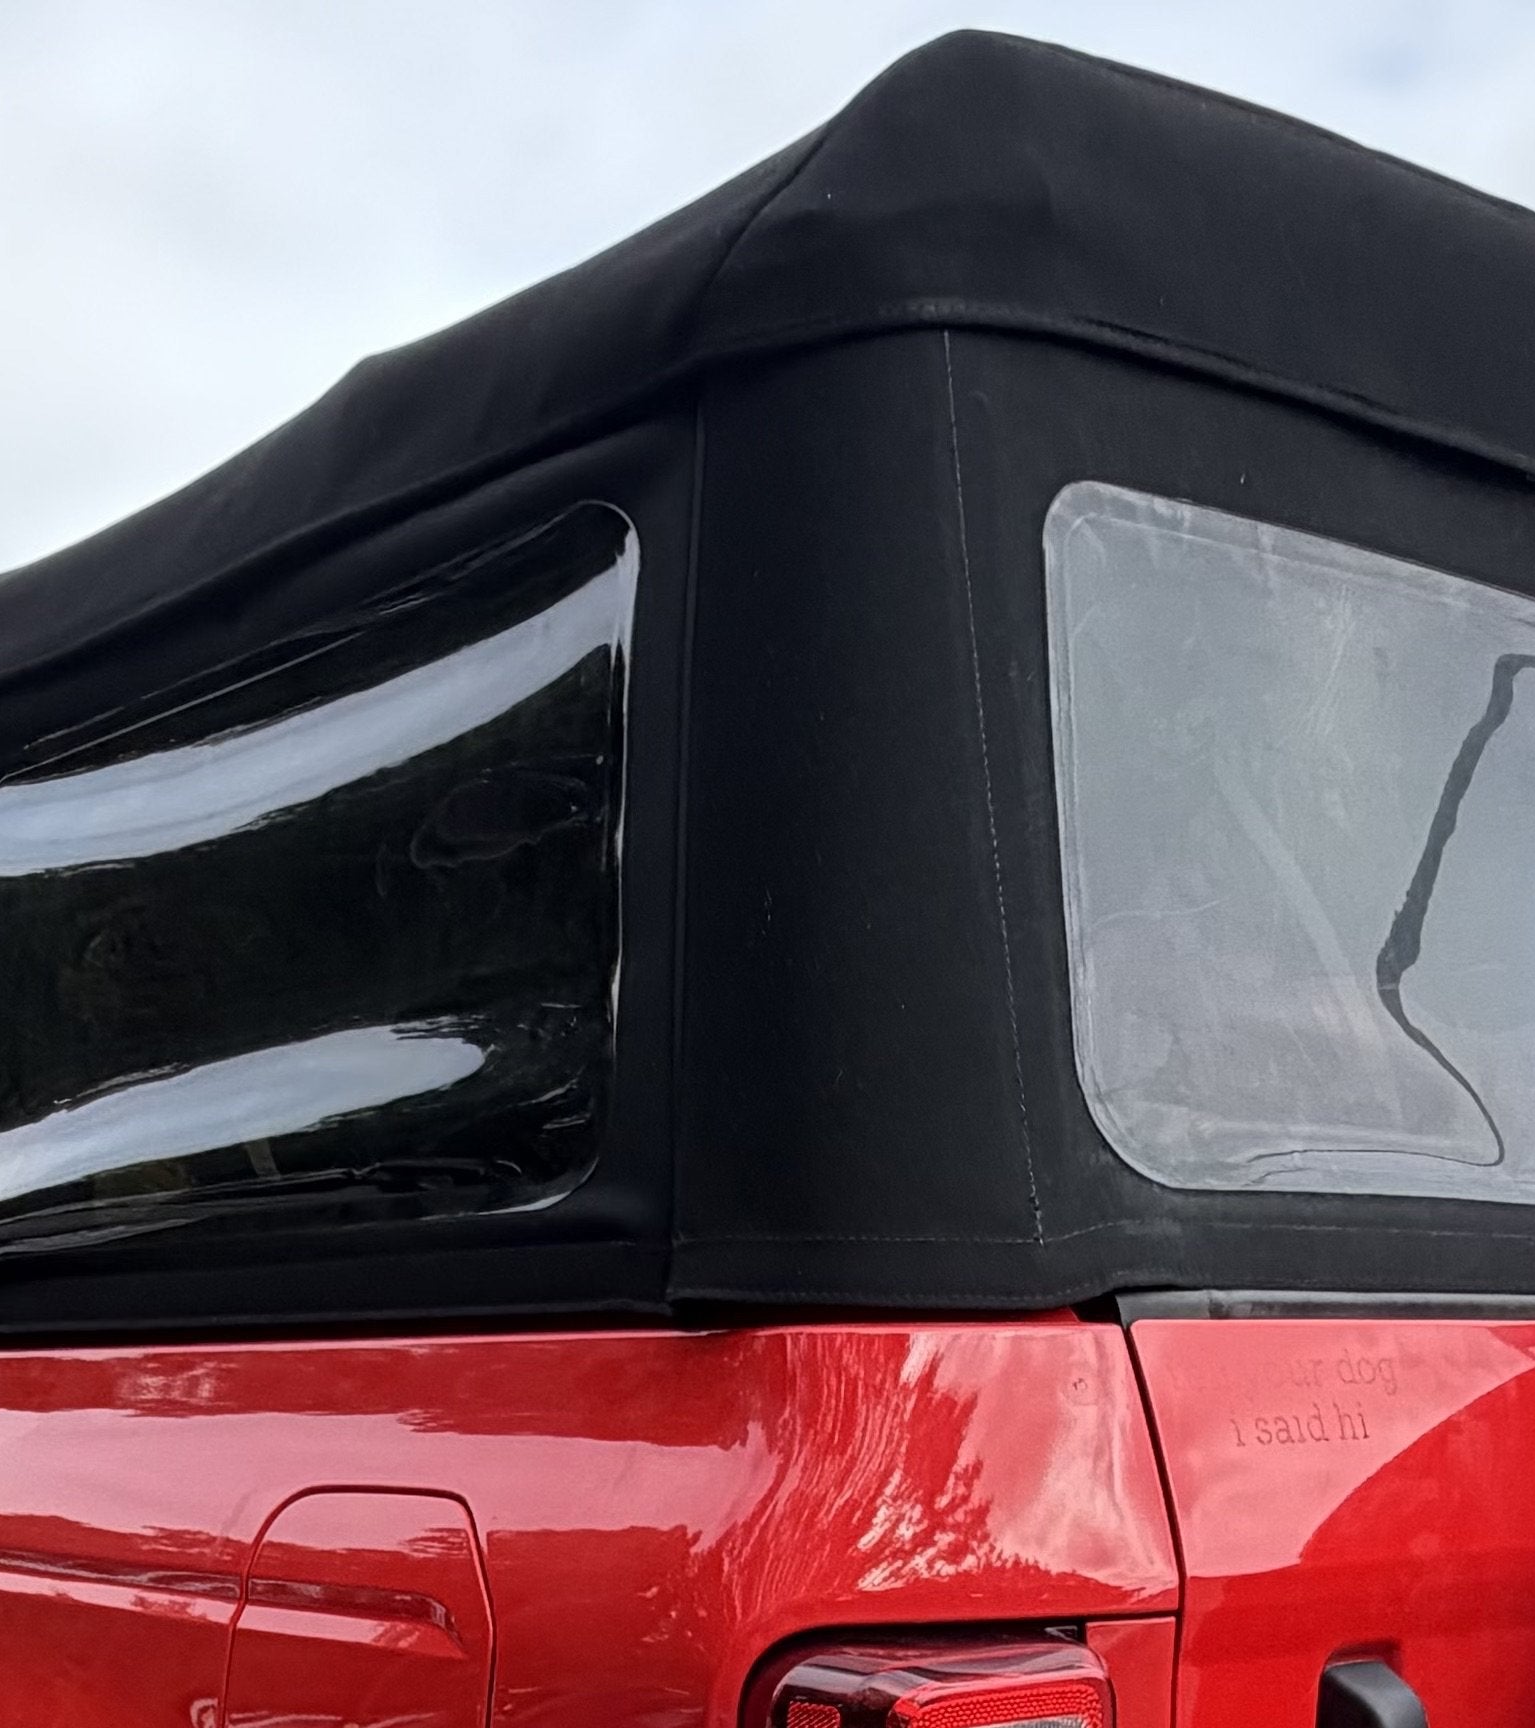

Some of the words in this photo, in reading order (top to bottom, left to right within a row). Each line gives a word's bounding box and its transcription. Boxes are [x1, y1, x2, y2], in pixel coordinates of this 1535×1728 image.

[1337, 1349, 1398, 1396] dog
[1230, 1408, 1247, 1448] i
[1254, 1401, 1330, 1446] said
[1331, 1400, 1371, 1442] hi
